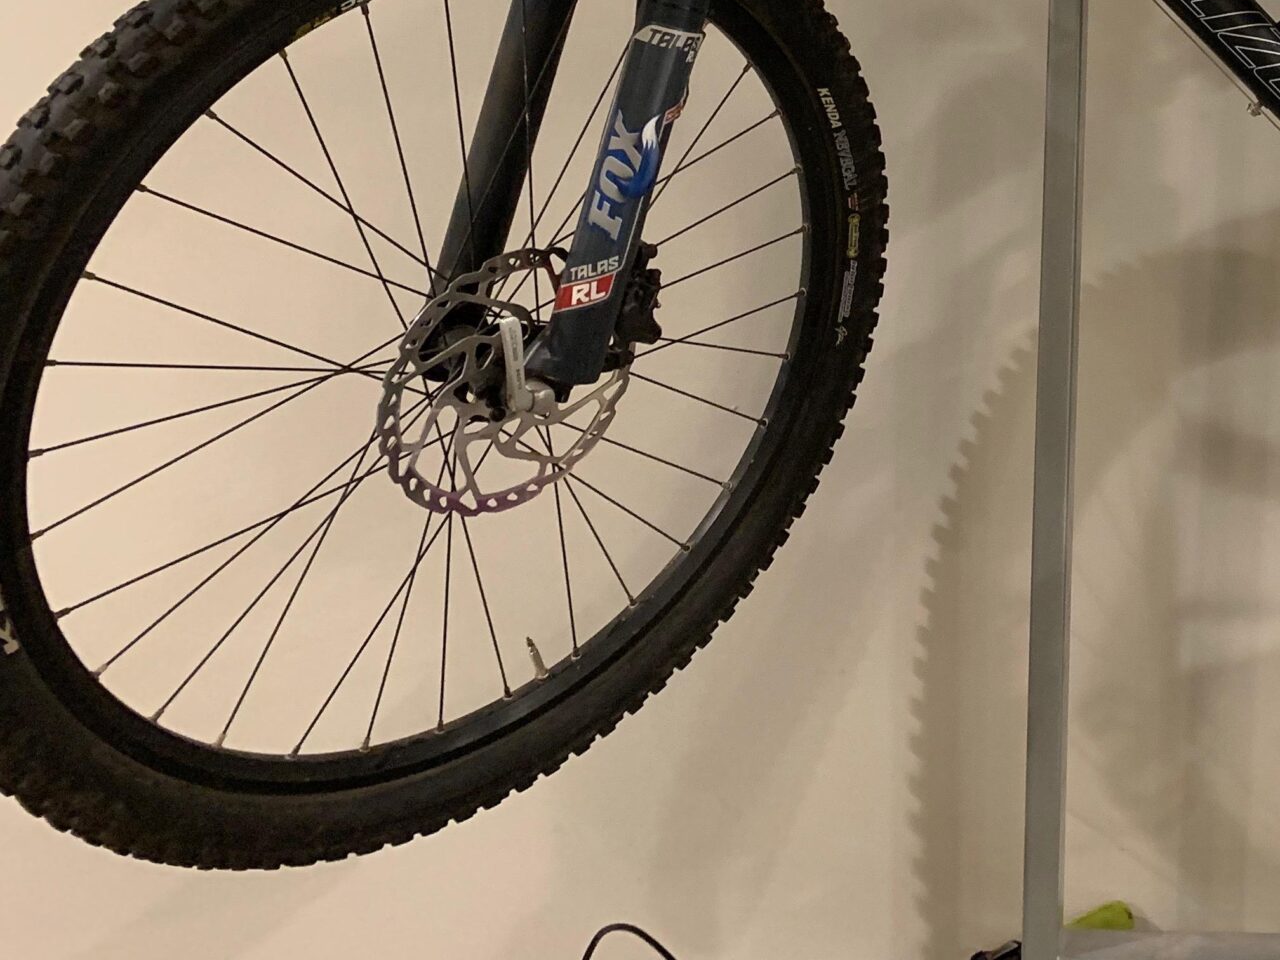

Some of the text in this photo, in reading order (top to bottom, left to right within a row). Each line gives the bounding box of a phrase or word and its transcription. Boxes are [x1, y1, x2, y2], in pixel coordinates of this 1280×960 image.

[817, 87, 839, 129] KENDA
[587, 110, 642, 241] FOX
[570, 255, 620, 280] TALAS
[571, 280, 606, 305] RL
